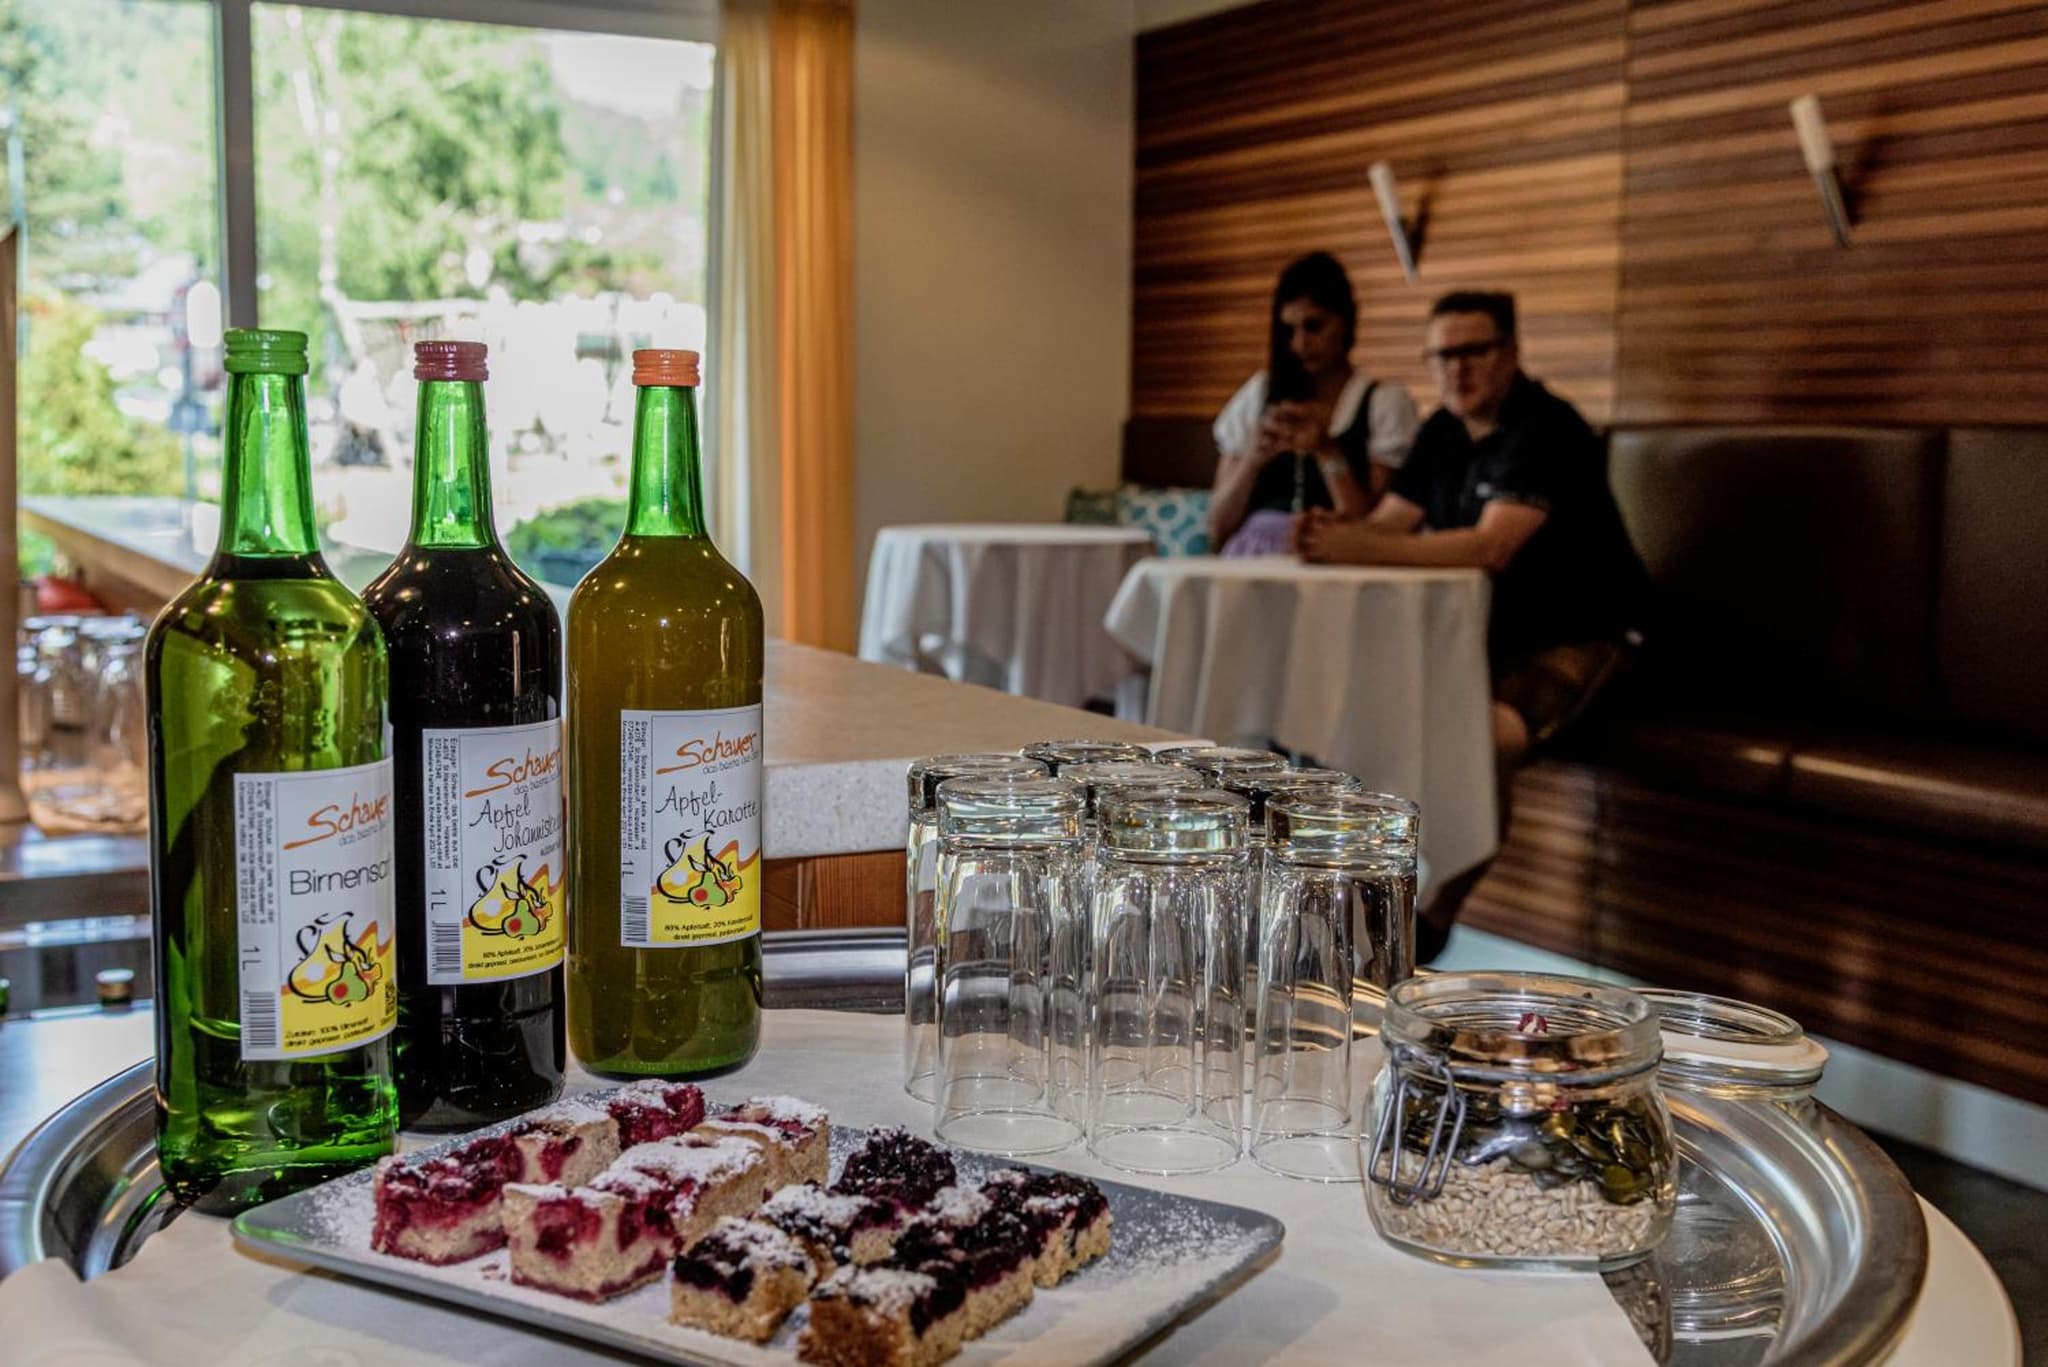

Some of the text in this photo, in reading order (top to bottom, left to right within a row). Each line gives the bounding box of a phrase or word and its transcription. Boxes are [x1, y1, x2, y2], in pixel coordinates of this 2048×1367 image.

[656, 730, 757, 776] Schauer
[469, 793, 531, 829] Apfel
[703, 801, 759, 830] Karotte
[622, 871, 634, 879] L
[431, 888, 447, 912] 1 L
[242, 944, 261, 953] 1
[242, 959, 262, 971] L
